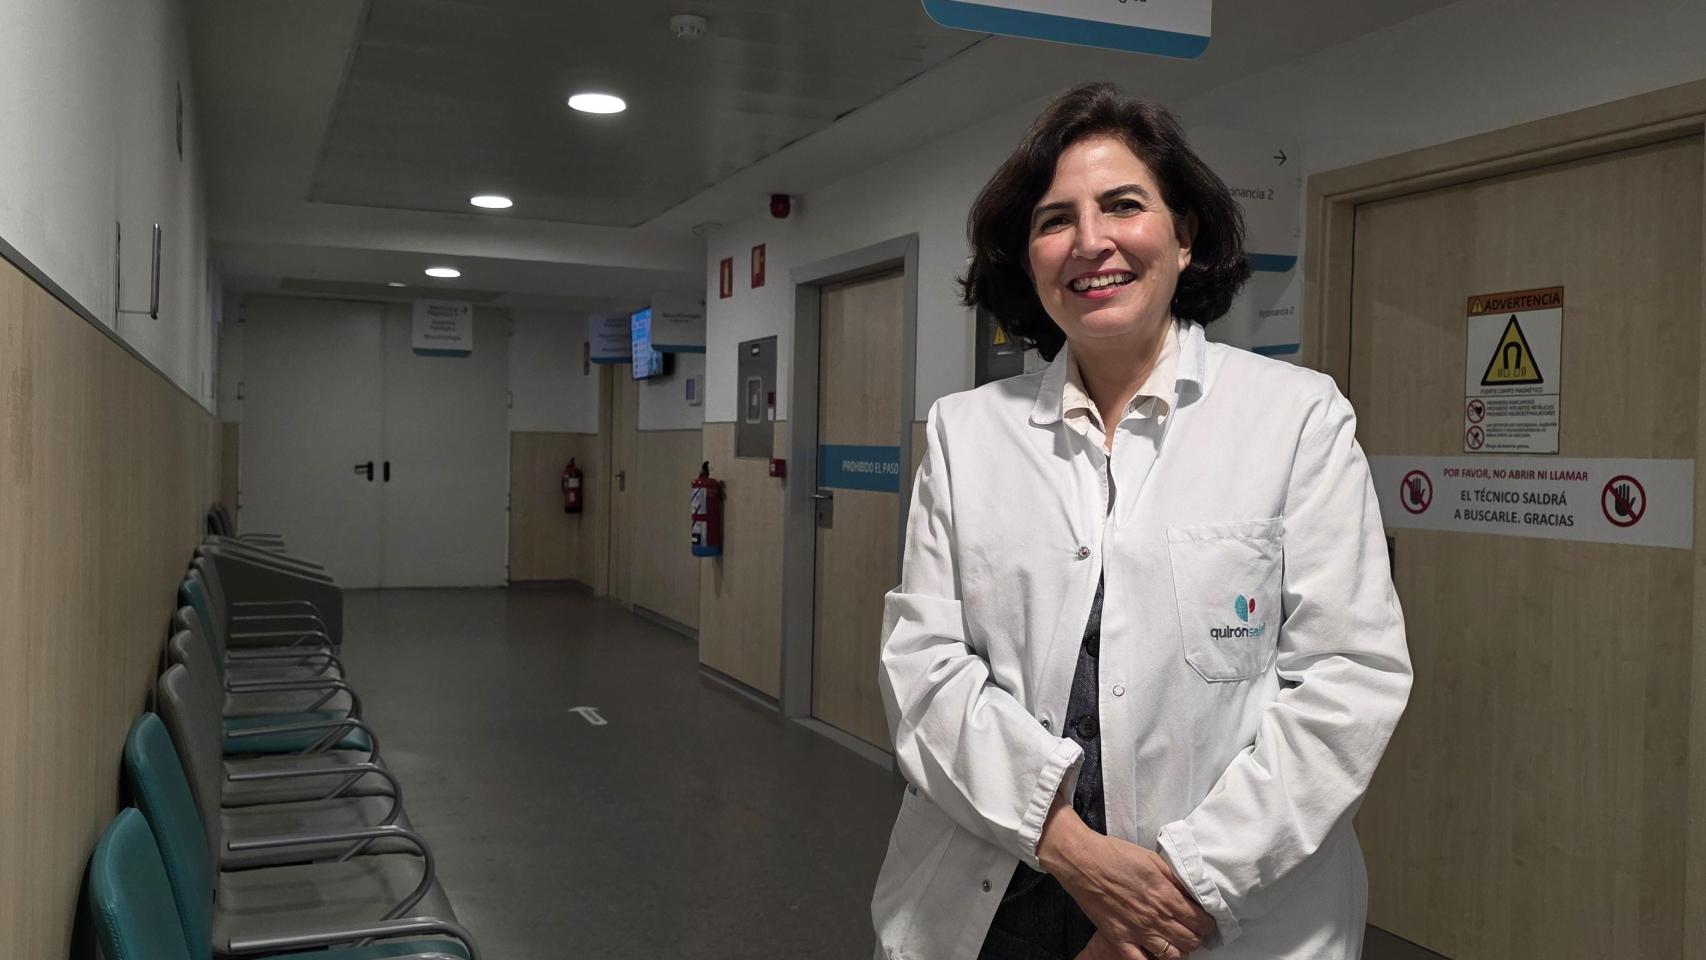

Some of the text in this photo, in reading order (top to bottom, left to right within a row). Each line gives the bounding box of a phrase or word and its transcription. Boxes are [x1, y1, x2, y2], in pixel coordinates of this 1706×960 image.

[1268, 189, 1274, 200] 2
[1484, 293, 1560, 312] ADVERTENCIA
[842, 460, 899, 474] PROHIBIDO EL PASO
[1443, 468, 1588, 481] POR FAVOR, NO ABRIR NI LLAMAR
[1460, 488, 1567, 506] EL TÉCNICO SALDRÁ
[1454, 508, 1574, 527] A BUSCARLE. GRACIAS
